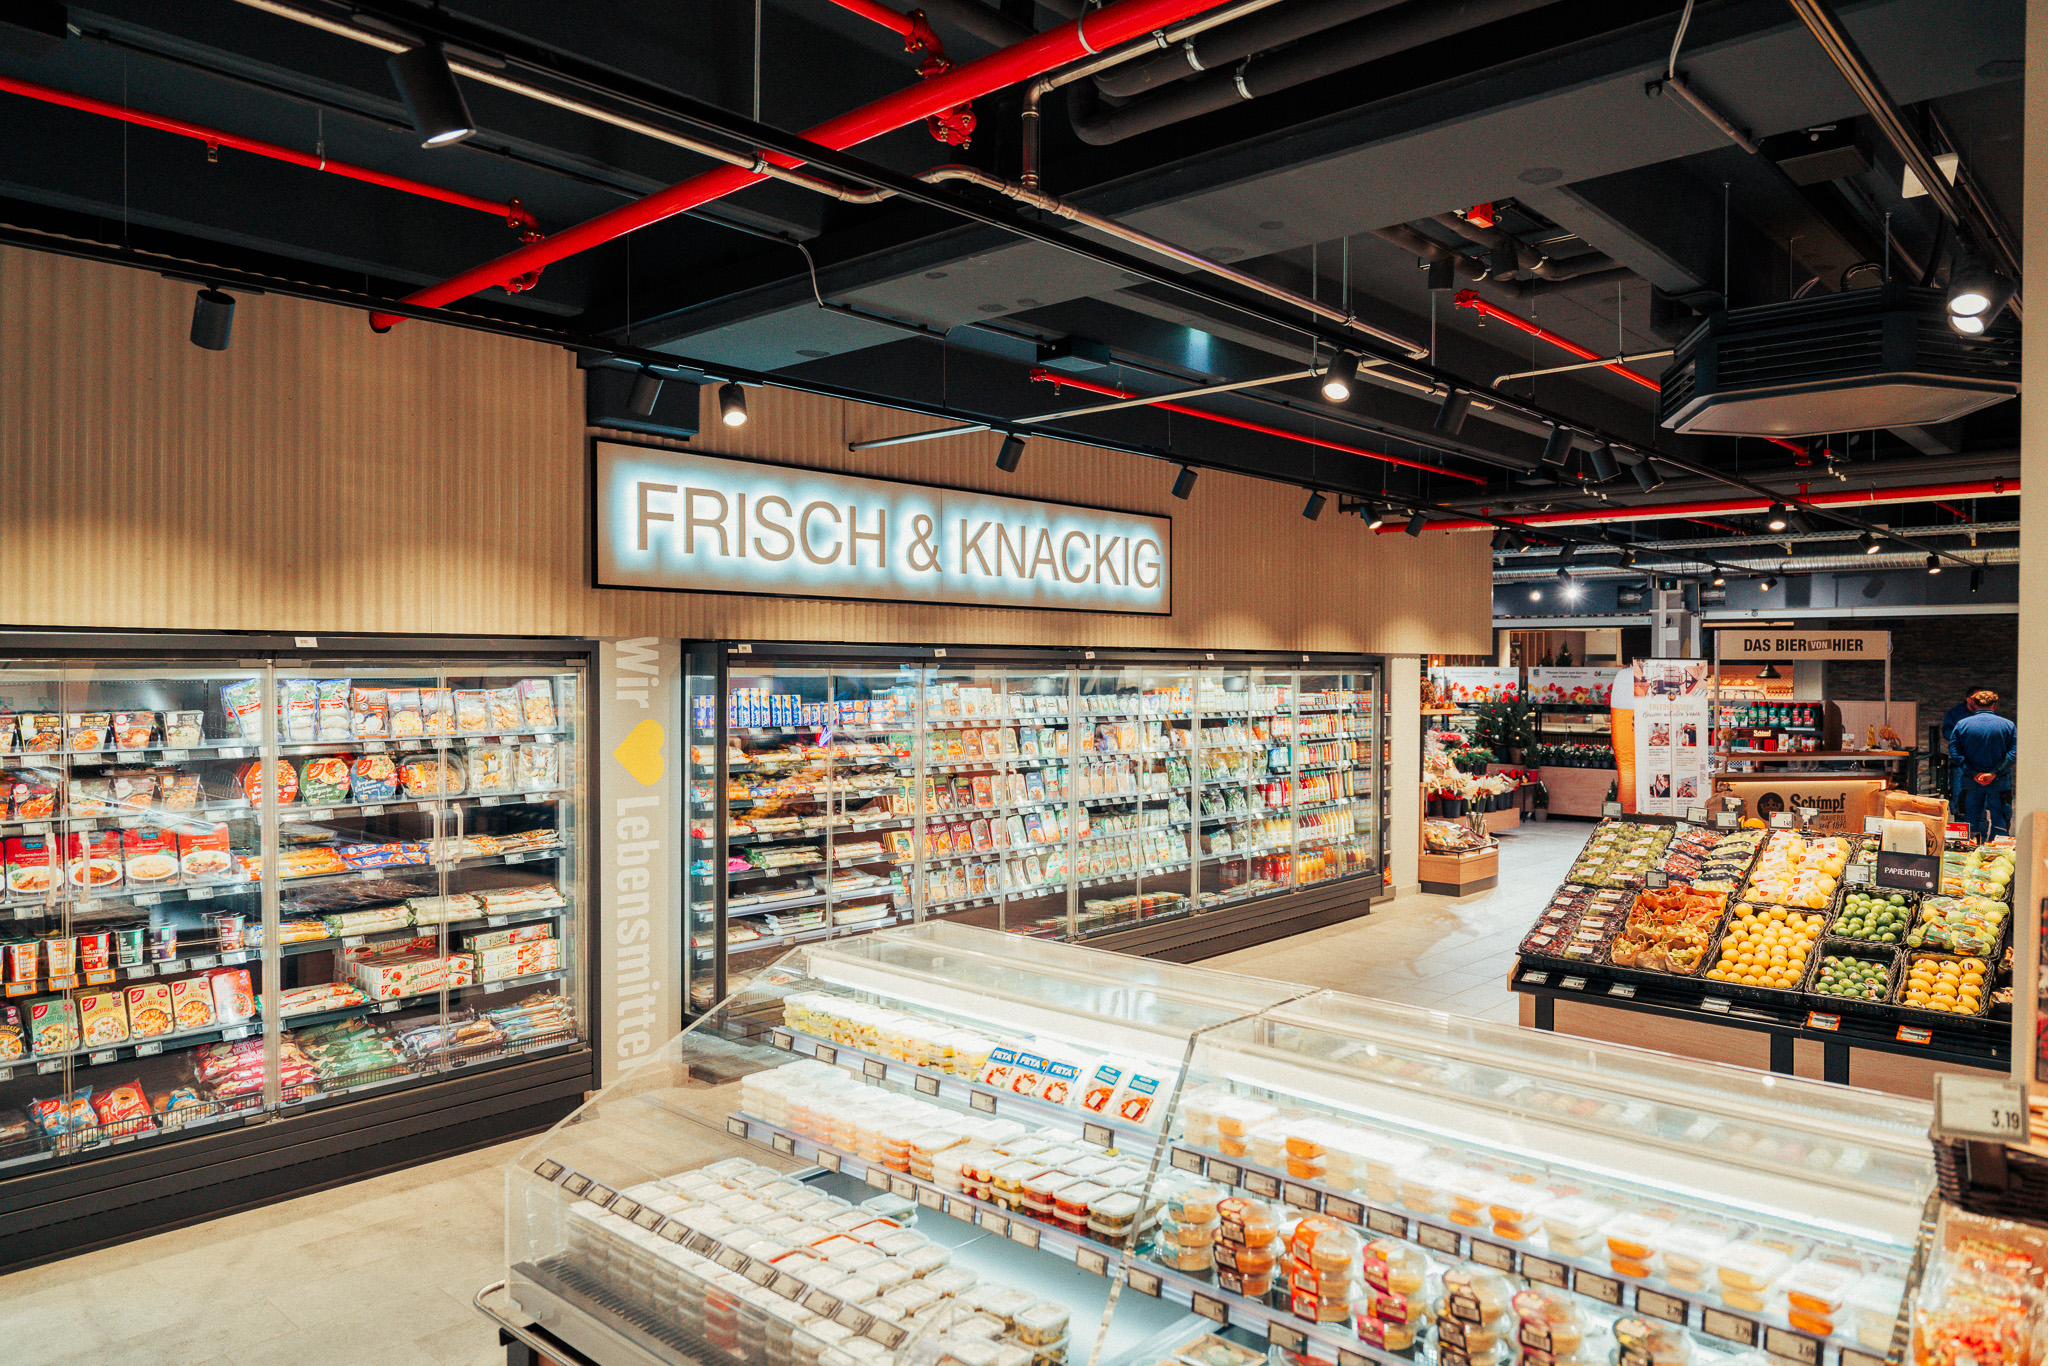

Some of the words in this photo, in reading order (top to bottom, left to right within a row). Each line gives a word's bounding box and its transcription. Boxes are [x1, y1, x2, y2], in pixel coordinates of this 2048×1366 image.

[636, 481, 887, 569] FRISCH
[907, 514, 943, 573] &
[960, 518, 1162, 590] KNACKIG
[1744, 638, 1771, 652] DAS
[1775, 638, 1807, 652] BIER
[1810, 640, 1828, 650] VON
[1832, 638, 1864, 652] HIER
[616, 636, 659, 708] Wir
[1789, 793, 1846, 813] Schimpf
[932, 825, 946, 833] Valess
[953, 824, 967, 832] Valess
[1884, 866, 1930, 878] PAPIERTÜTEN
[616, 796, 661, 1070] Lebensmittel
[412, 980, 429, 990] PIZZA
[992, 1051, 1012, 1062] FETA
[1019, 1056, 1042, 1069] FETA
[1051, 1065, 1073, 1077] FETA
[1991, 1109, 2020, 1130] 3.19
